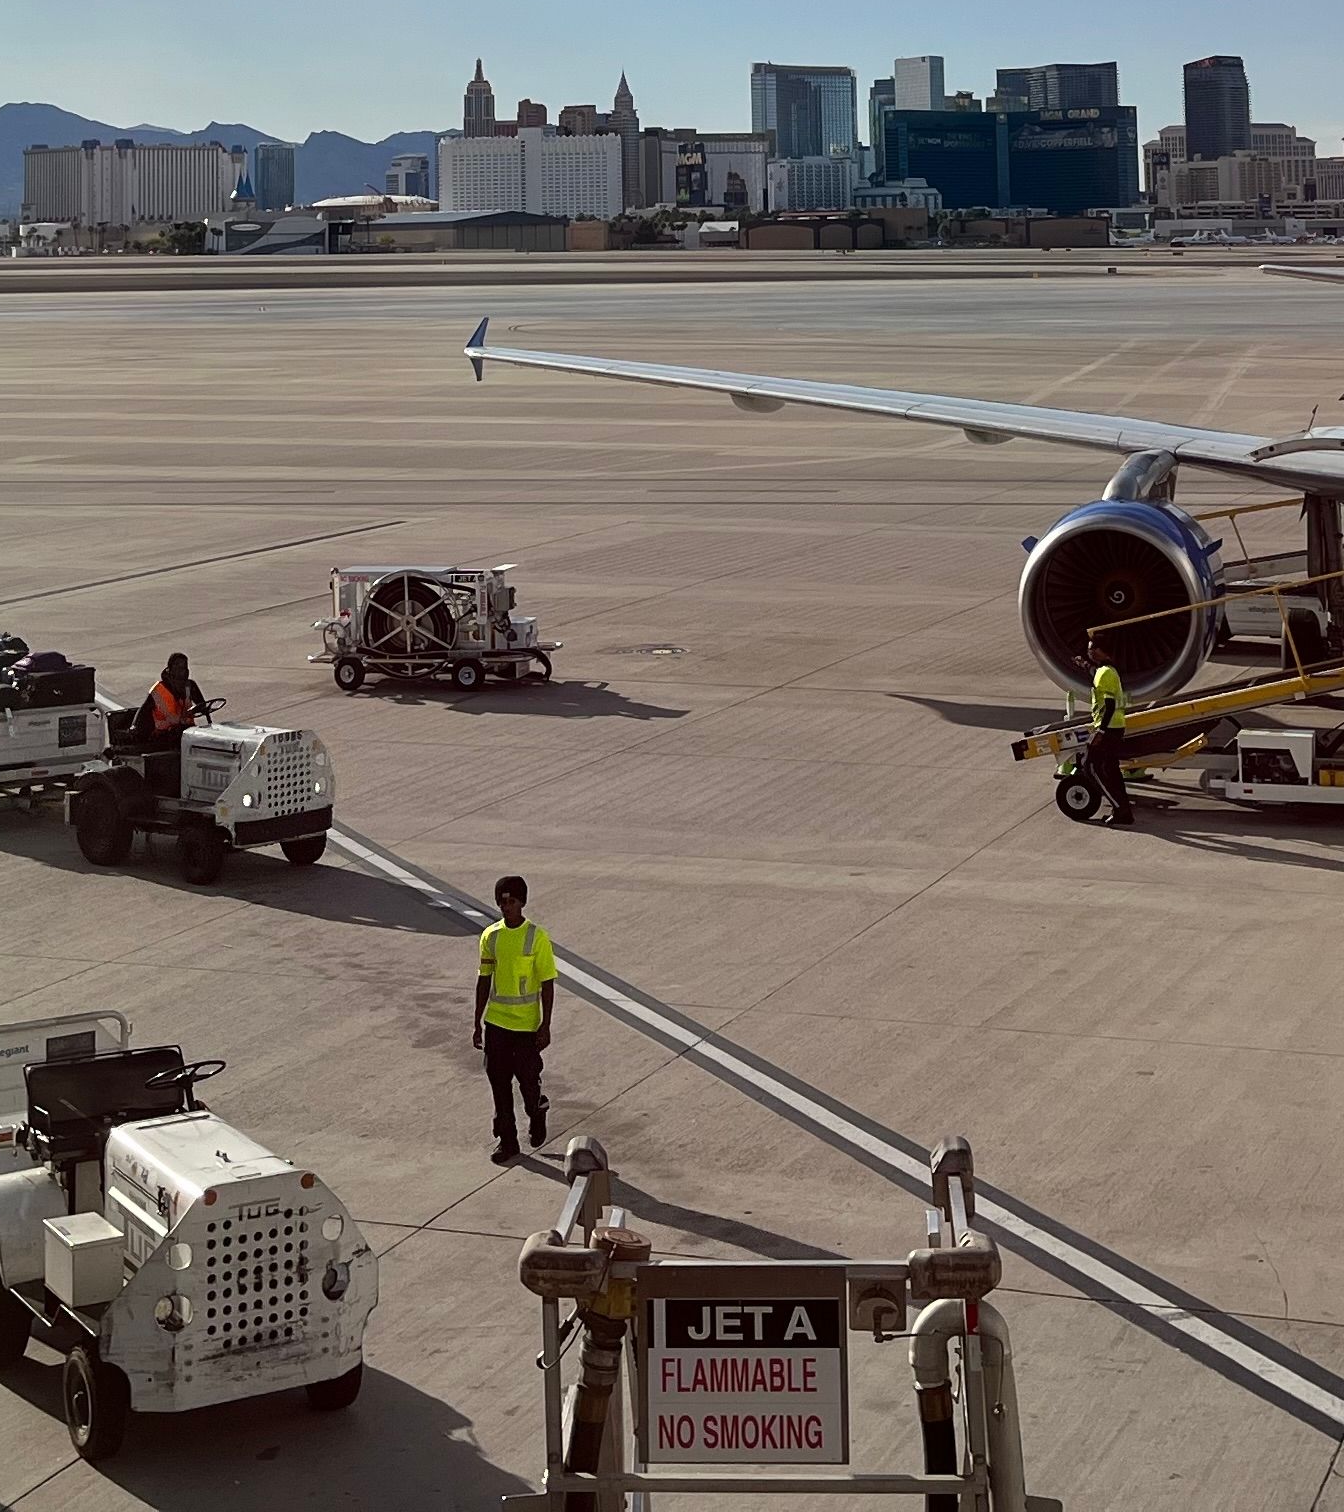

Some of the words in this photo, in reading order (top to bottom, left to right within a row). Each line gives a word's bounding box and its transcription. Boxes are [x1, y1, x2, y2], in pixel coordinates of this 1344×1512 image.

[1040, 110, 1064, 121] MGM
[1067, 108, 1100, 119] GRAND
[677, 152, 702, 165] MGM
[229, 1197, 280, 1221] TUG
[687, 1306, 773, 1340] JET
[783, 1306, 817, 1340] A
[661, 1358, 818, 1392] FLAMMABLE
[659, 1415, 696, 1449] NO
[703, 1415, 823, 1449] SMOKING
